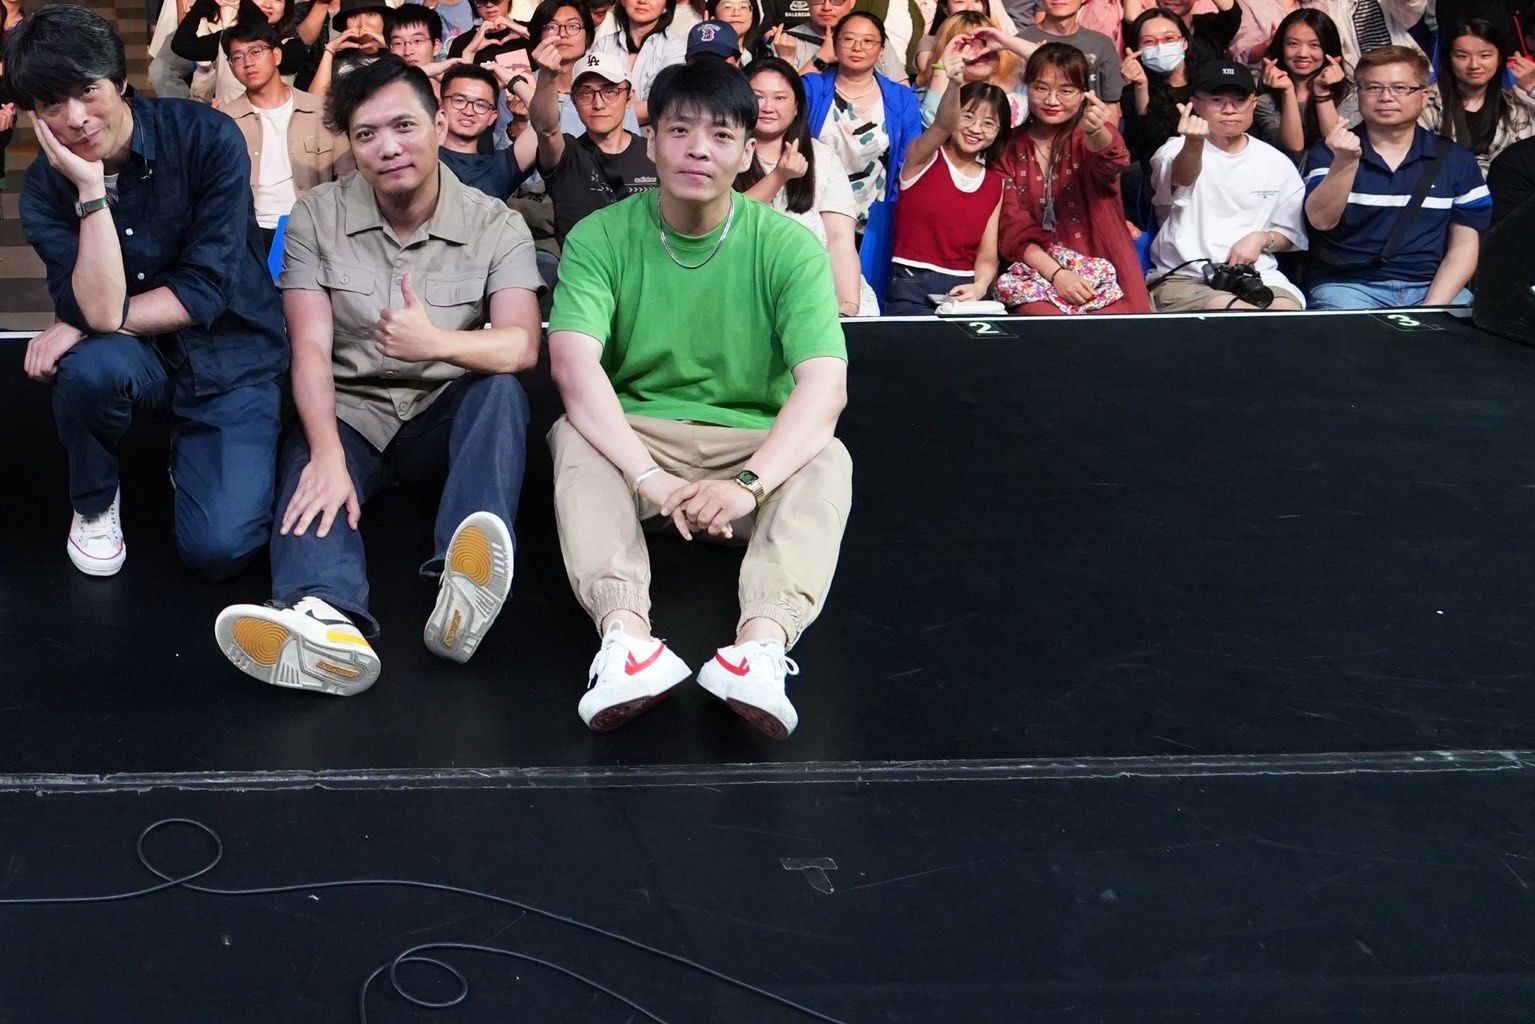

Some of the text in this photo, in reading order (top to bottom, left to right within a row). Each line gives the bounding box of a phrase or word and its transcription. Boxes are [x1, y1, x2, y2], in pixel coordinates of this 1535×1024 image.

[587, 54, 600, 67] LA
[1387, 314, 1420, 327] 3
[968, 321, 1000, 334] 2
